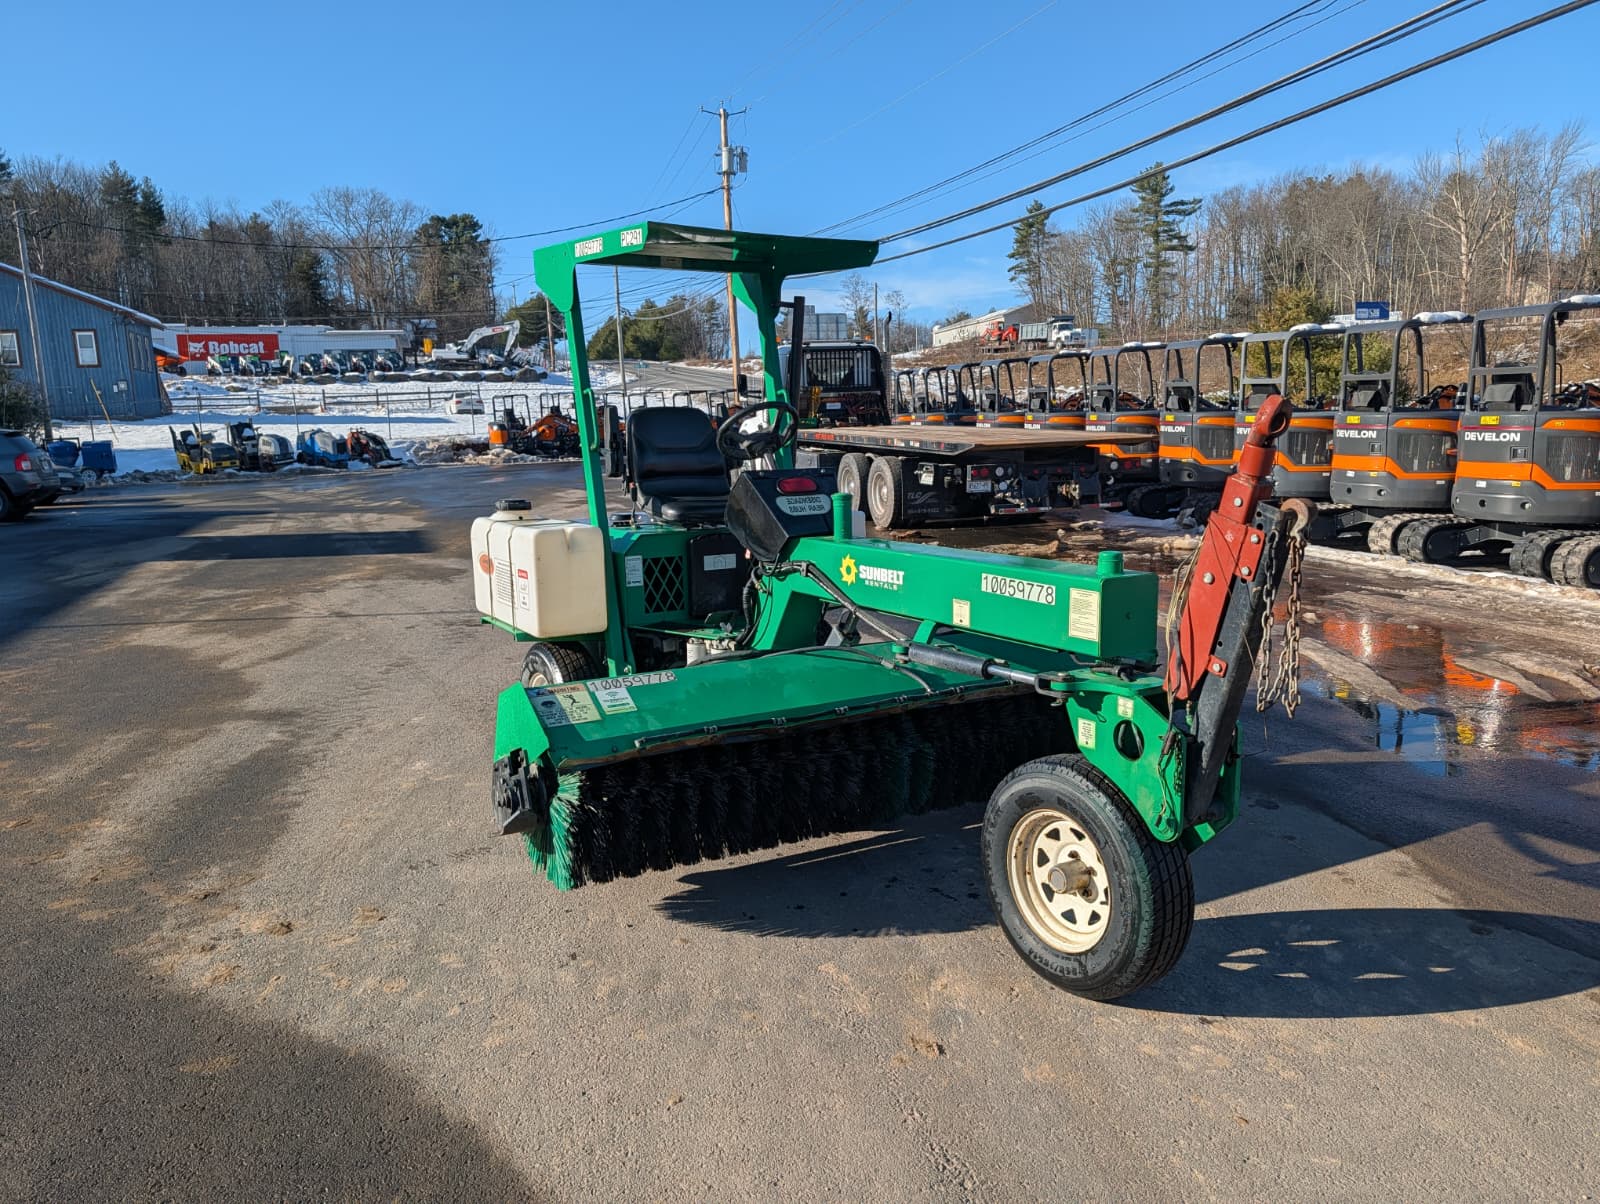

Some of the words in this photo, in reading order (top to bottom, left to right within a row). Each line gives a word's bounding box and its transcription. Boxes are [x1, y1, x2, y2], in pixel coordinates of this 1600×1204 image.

[208, 341, 264, 354] Bobcat
[1336, 429, 1377, 439] DEVELON
[1464, 431, 1521, 442] DEVELON
[859, 564, 905, 585] SUNBELT
[864, 579, 898, 591] RENTALS
[983, 575, 1055, 604] 10059778
[590, 670, 676, 692] 10059778
